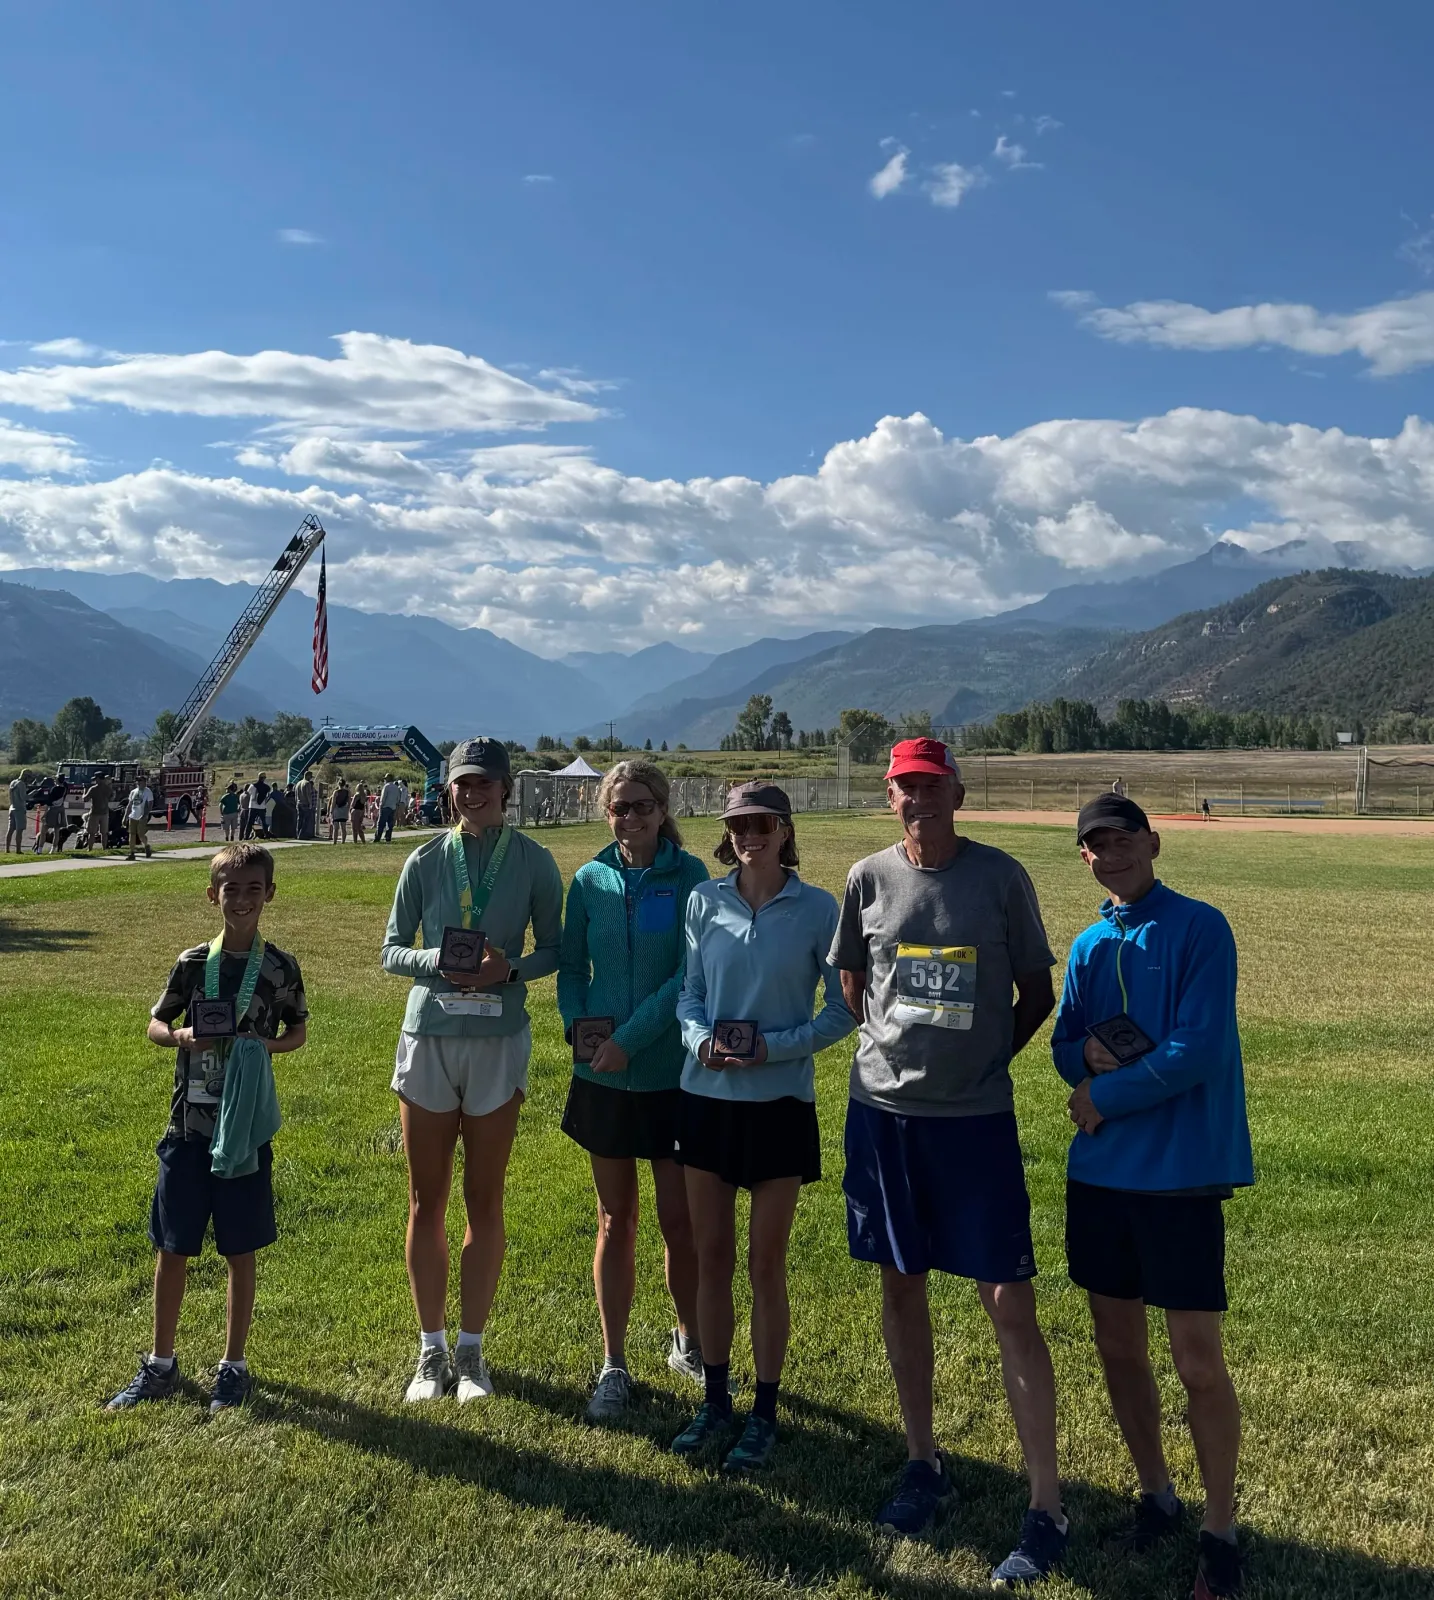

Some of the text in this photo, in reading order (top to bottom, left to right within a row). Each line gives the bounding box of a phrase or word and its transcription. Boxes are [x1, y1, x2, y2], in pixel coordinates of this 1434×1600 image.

[472, 905, 482, 916] 25
[953, 951, 967, 959] 10K
[910, 960, 960, 991] 532
